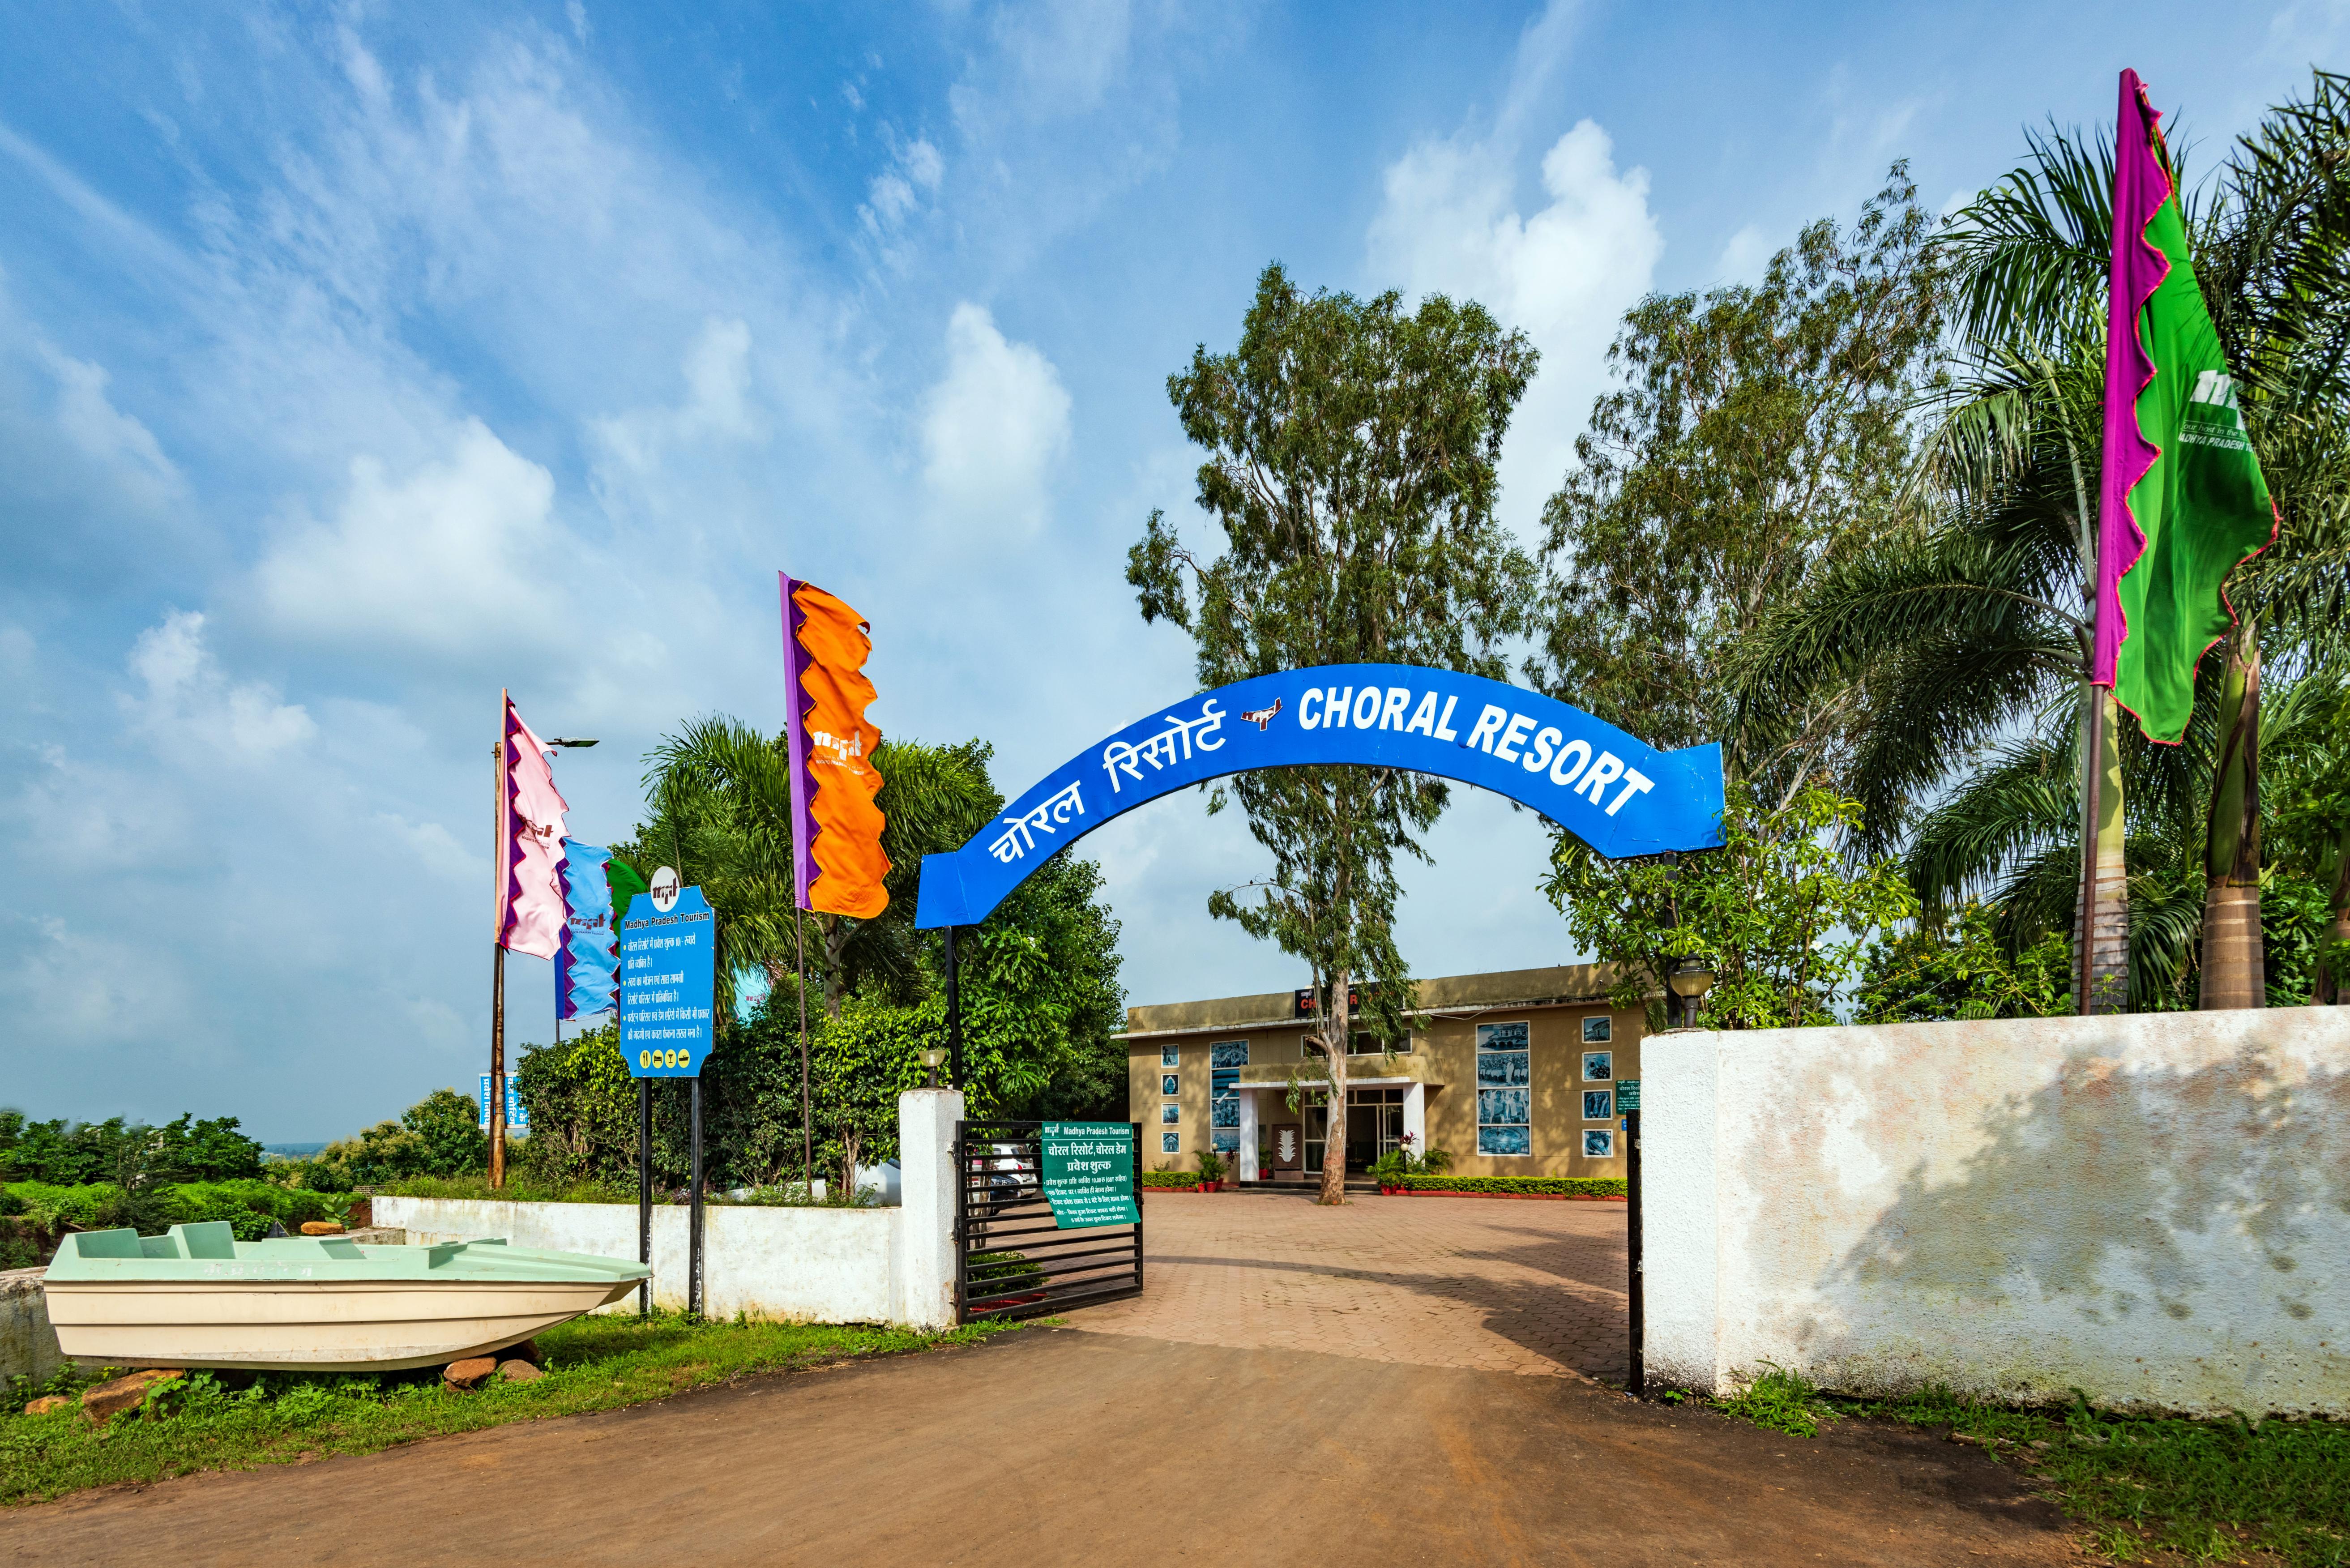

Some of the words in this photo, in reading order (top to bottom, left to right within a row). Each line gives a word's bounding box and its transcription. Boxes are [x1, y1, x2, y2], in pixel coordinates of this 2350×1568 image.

[2180, 422, 2196, 430] our
[2198, 424, 2215, 433] host
[2207, 437, 2245, 450] PRADESH
[1299, 686, 1458, 742] CHORAL
[1467, 704, 1655, 816] RESORT
[988, 779, 1085, 863] चोरल
[1102, 699, 1226, 793] रिसोर्ट
[625, 919, 649, 930] Madhya
[651, 914, 678, 926] Pradesh
[680, 911, 709, 923] Tourism
[638, 937, 649, 950] रिसोर्ट
[654, 935, 663, 949] प्रवेश
[664, 937, 675, 951] शुल्क
[628, 975, 636, 987] स्वयं
[637, 977, 641, 986] का
[643, 973, 653, 986] भोजन
[670, 970, 684, 983] सामग्री
[639, 991, 650, 1004] परिसर
[639, 1009, 651, 1022] परिसर
[680, 1007, 691, 1020] किसी
[692, 1006, 697, 1019] भी
[698, 1009, 710, 1019] प्रकार
[688, 1028, 696, 1038] मना
[1064, 1127, 1085, 1137] Madhya
[1086, 1127, 1108, 1135] Pradesh
[1109, 1127, 1129, 1135] Tourism
[1048, 1142, 1069, 1156] चोरल
[1115, 1142, 1127, 1154] डेम
[1067, 1159, 1089, 1171] प्रवेश
[1090, 1161, 1111, 1174] शुल्क
[1057, 1179, 1068, 1187] शुल्क
